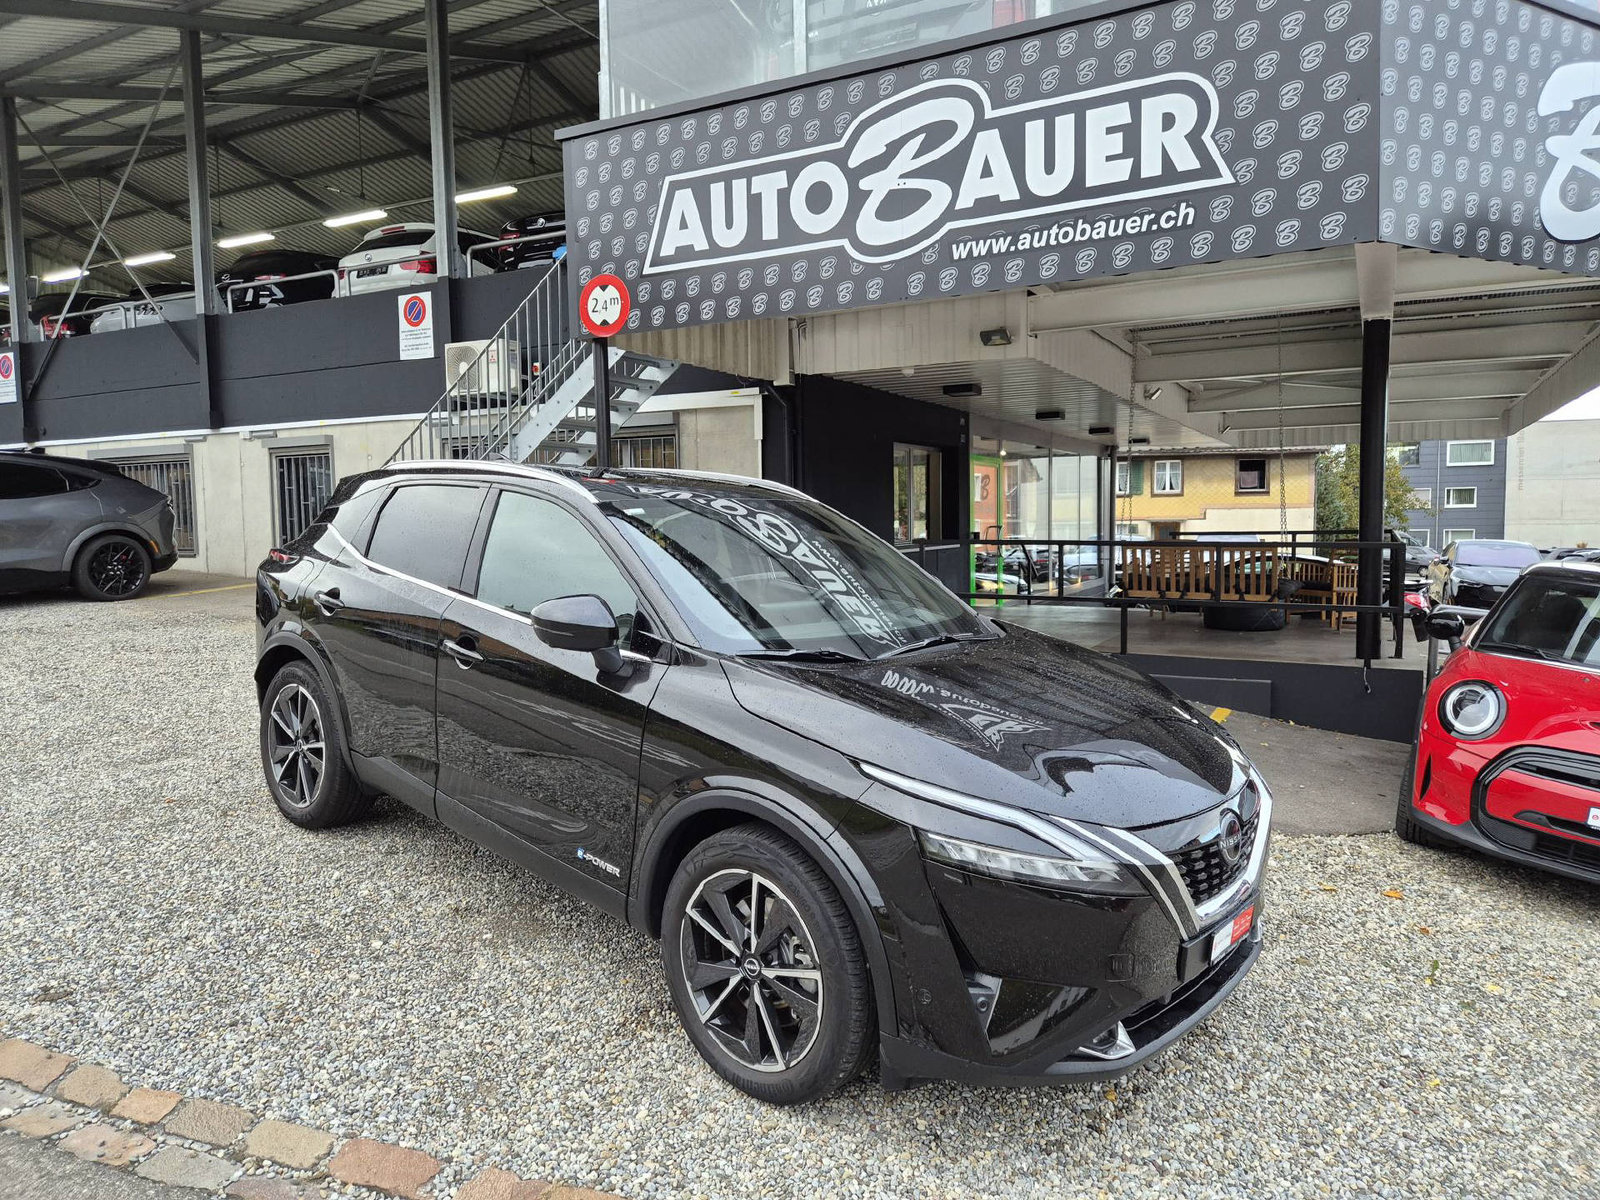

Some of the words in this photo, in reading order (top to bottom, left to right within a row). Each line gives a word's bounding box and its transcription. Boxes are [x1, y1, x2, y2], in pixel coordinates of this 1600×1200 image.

[659, 161, 850, 256] AUTO
[848, 91, 1202, 246] BAUER
[951, 202, 1196, 261] www.autobauer.ch
